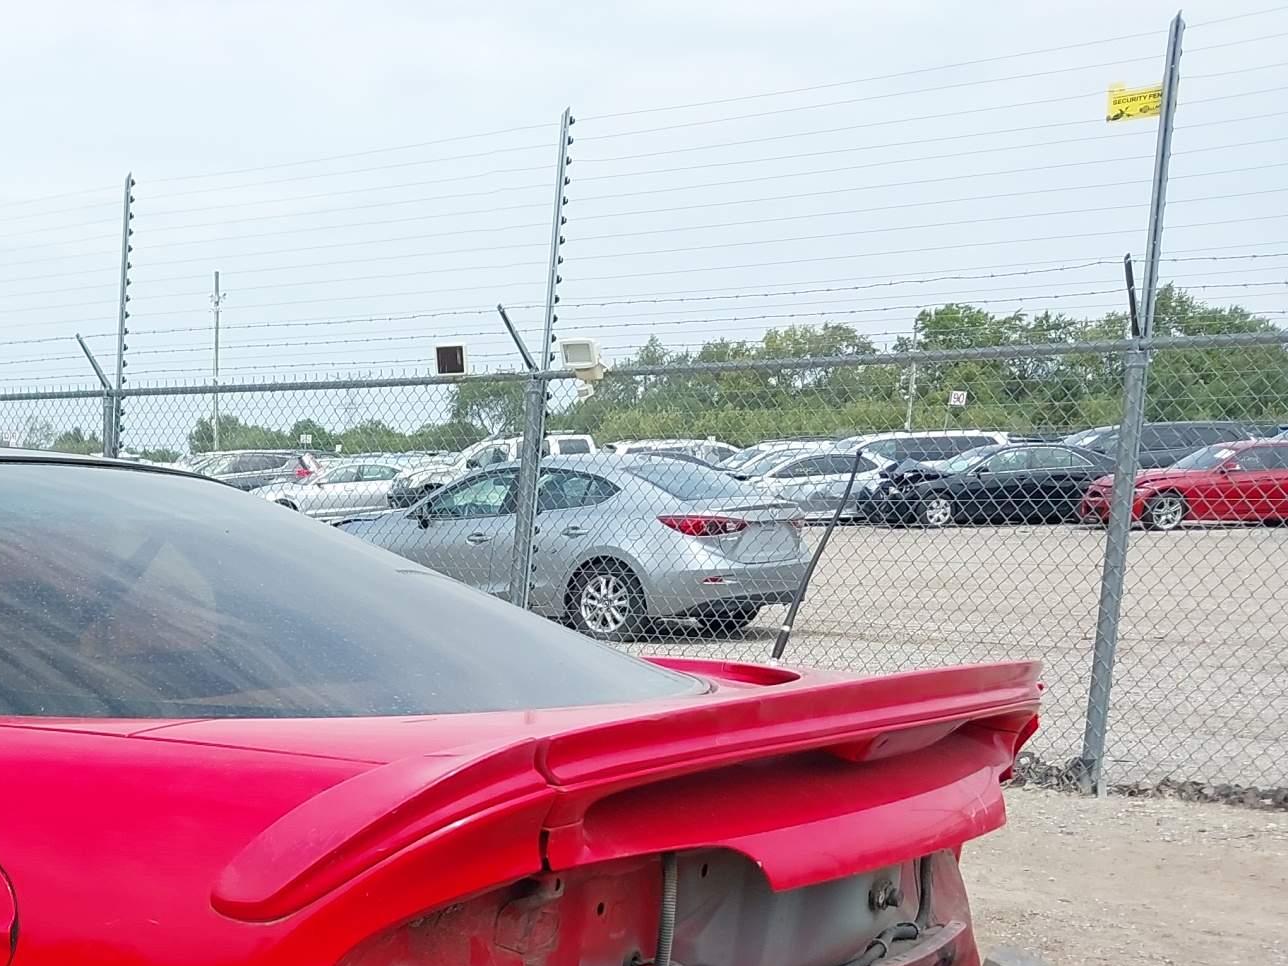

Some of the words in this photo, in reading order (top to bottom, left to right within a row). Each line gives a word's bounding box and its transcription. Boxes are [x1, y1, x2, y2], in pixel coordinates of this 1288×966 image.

[1112, 94, 1148, 106] SECURITY
[1148, 92, 1163, 101] FEN
[952, 392, 965, 404] 90
